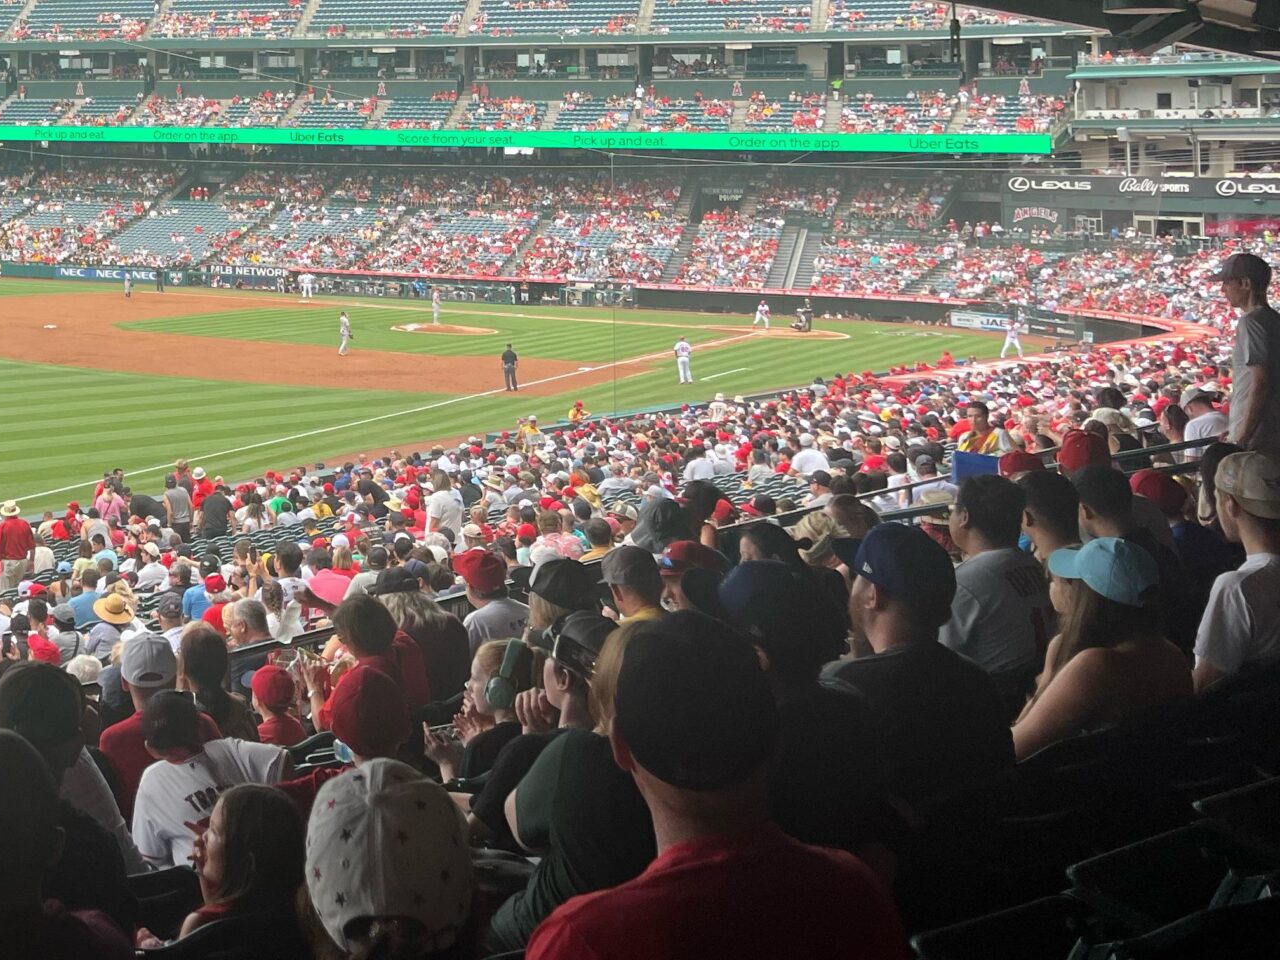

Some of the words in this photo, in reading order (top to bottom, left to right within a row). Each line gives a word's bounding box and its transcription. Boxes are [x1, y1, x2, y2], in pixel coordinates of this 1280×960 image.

[34, 129, 53, 138] Pick
[54, 131, 67, 141] up
[68, 130, 88, 139] and
[153, 130, 182, 140] Order
[183, 132, 197, 140] on
[198, 130, 216, 140] the
[290, 132, 315, 141] Uber
[317, 132, 345, 142] Eats
[397, 133, 430, 143] Score
[432, 133, 459, 143] from
[461, 135, 486, 146] your
[573, 135, 596, 145] Pick
[600, 138, 616, 148] up
[618, 136, 642, 146] and
[728, 136, 766, 147] Order
[769, 138, 787, 148] on
[789, 137, 812, 148] the
[908, 139, 942, 149] Uber
[945, 139, 979, 150] Eats
[1031, 180, 1092, 190] LEXUS
[1118, 177, 1161, 195] Bally
[1159, 183, 1190, 192] SPORTS
[1012, 206, 1059, 223] ANGELS
[59, 267, 86, 277] NEC
[95, 269, 122, 279] NEC
[132, 270, 157, 280] NEC
[210, 265, 232, 275] MLB
